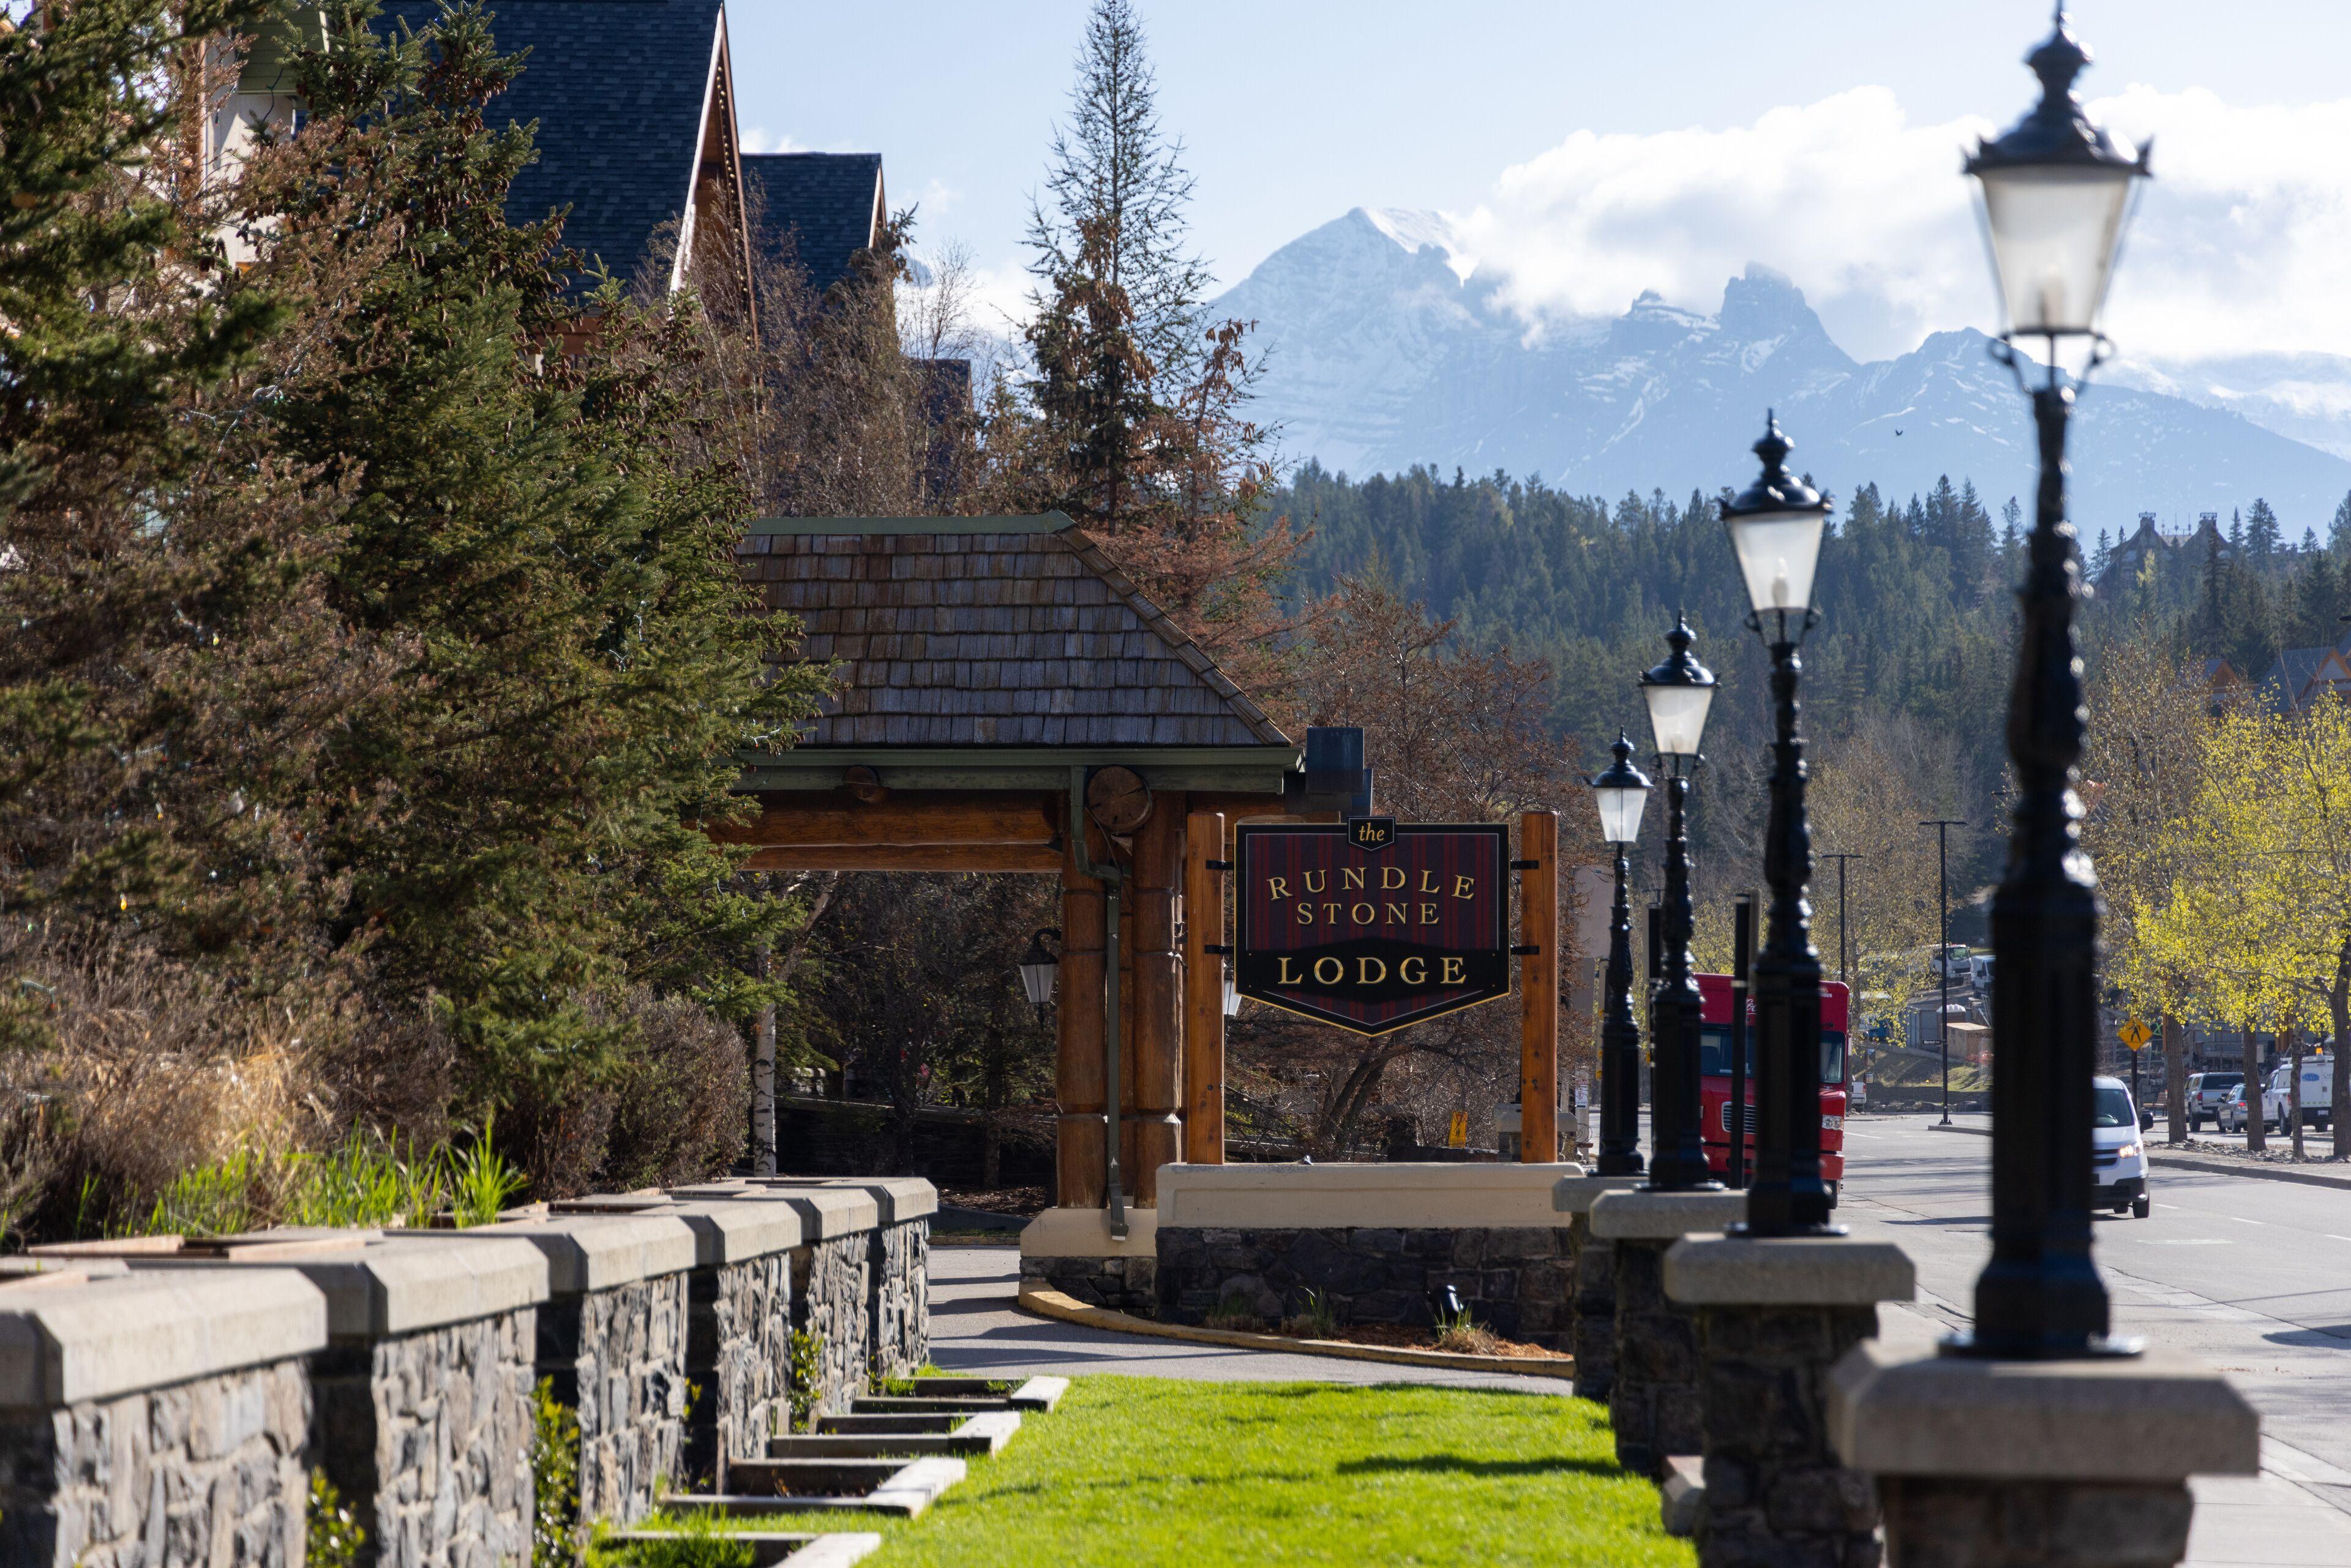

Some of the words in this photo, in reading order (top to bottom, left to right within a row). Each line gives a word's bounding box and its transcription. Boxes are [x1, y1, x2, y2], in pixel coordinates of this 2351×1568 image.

[1359, 822, 1385, 841] the
[1266, 867, 1475, 901] RUNDLE
[1296, 902, 1439, 925] STONE
[1277, 956, 1467, 985] LODGE
